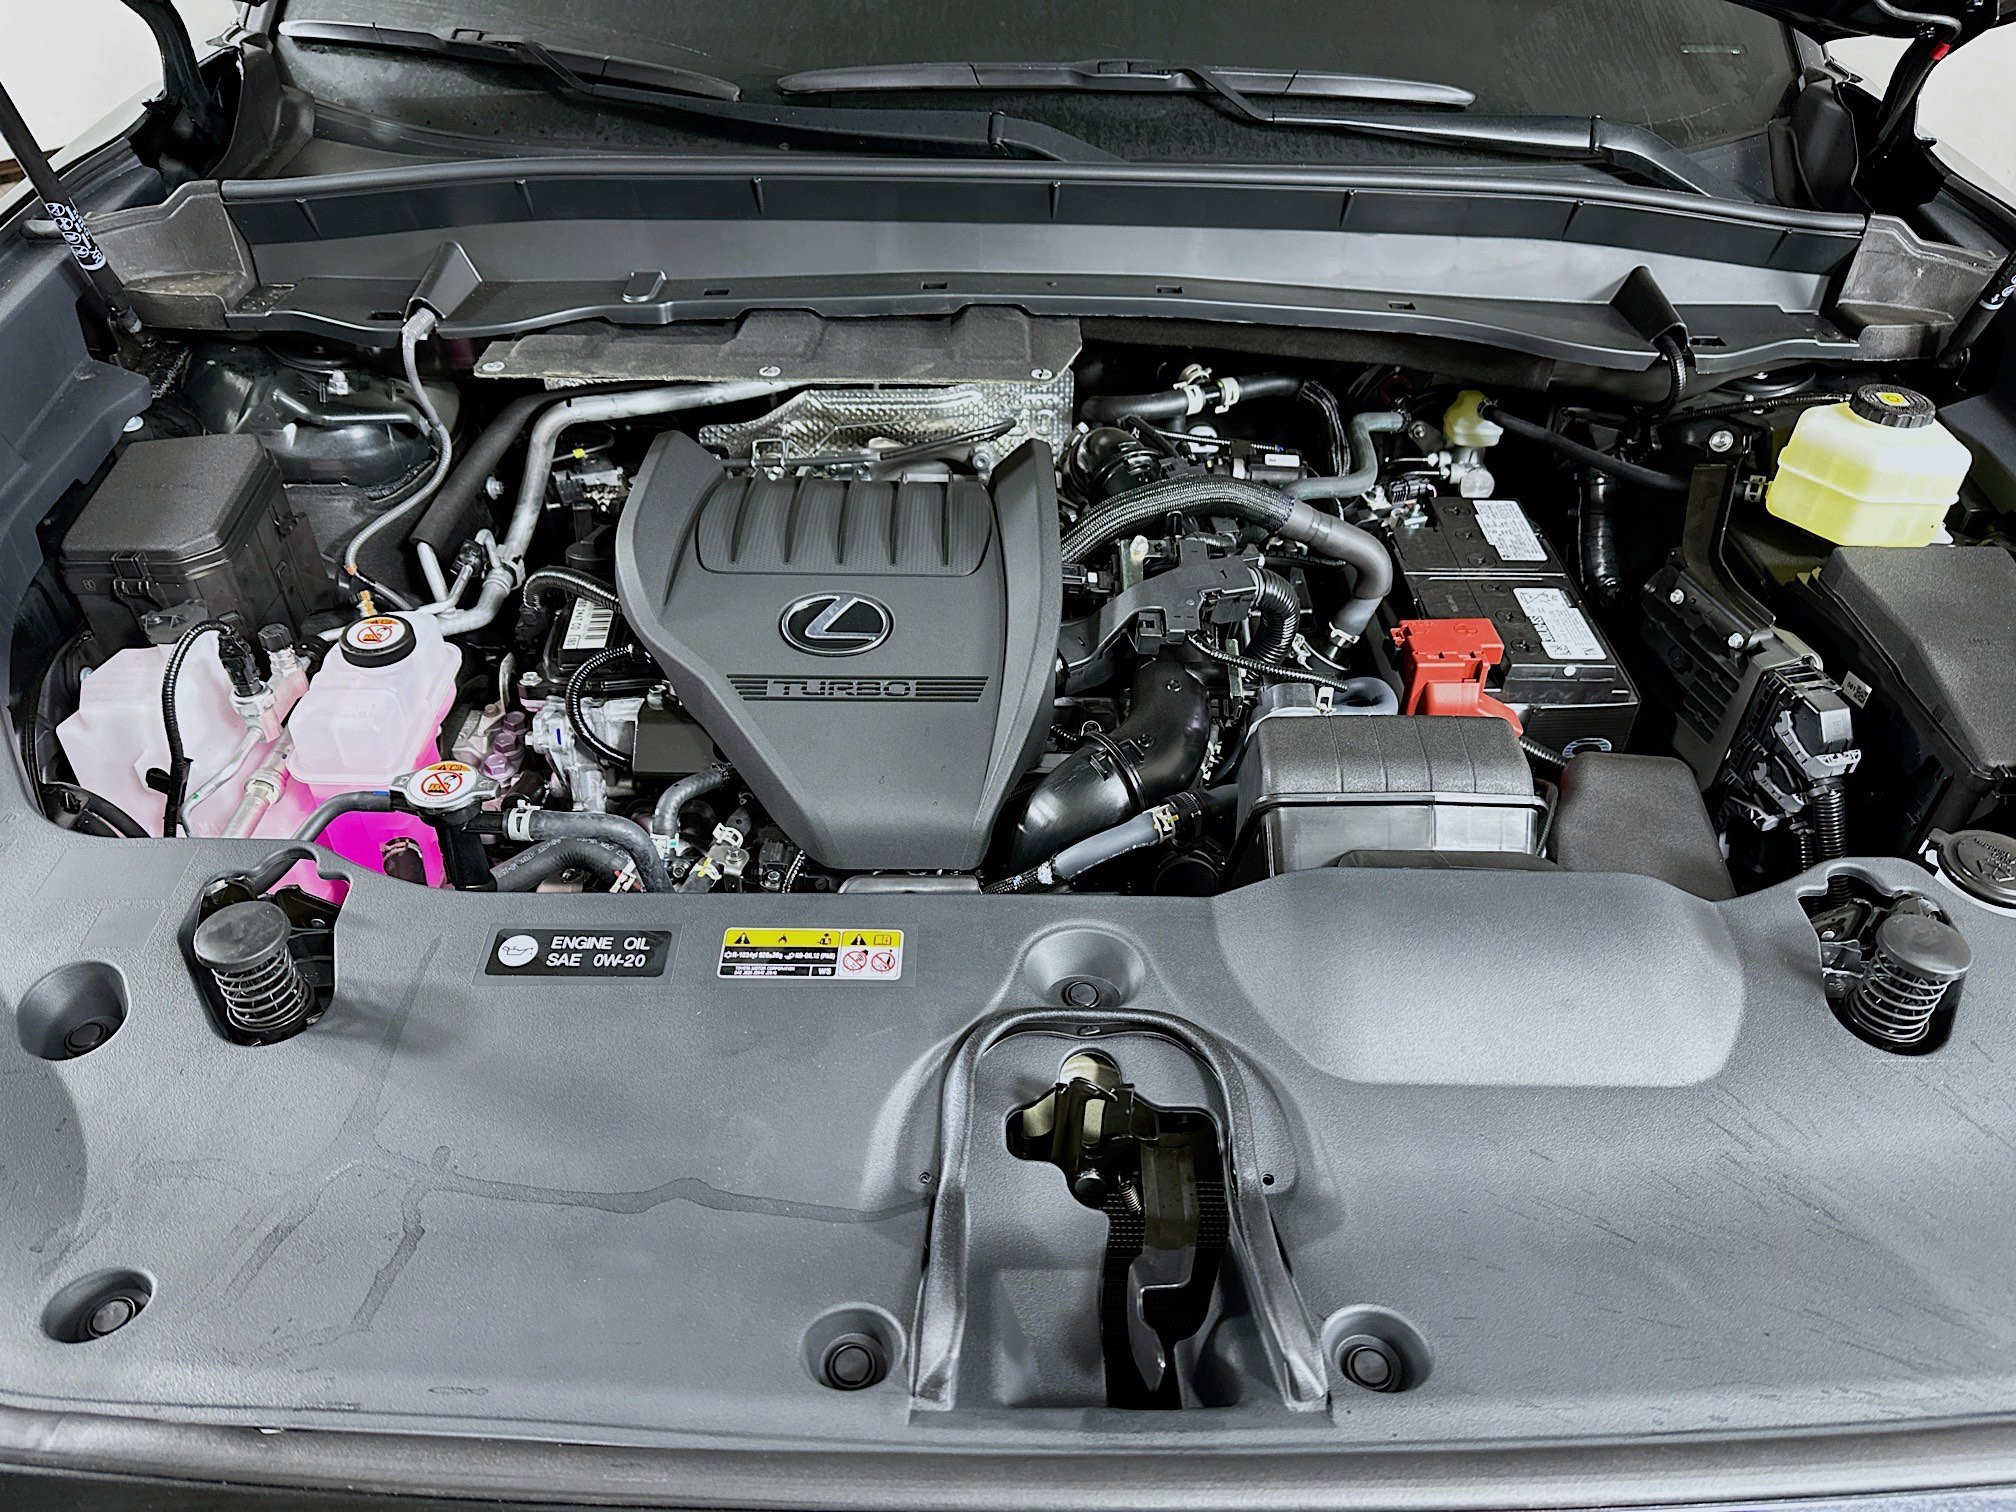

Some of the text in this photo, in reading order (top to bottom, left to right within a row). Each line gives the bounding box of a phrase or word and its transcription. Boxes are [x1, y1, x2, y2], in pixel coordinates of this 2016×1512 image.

[773, 680, 911, 697] TURBO
[550, 936, 651, 951] ENGINE OIL
[546, 953, 646, 968] SAE 0W-20
